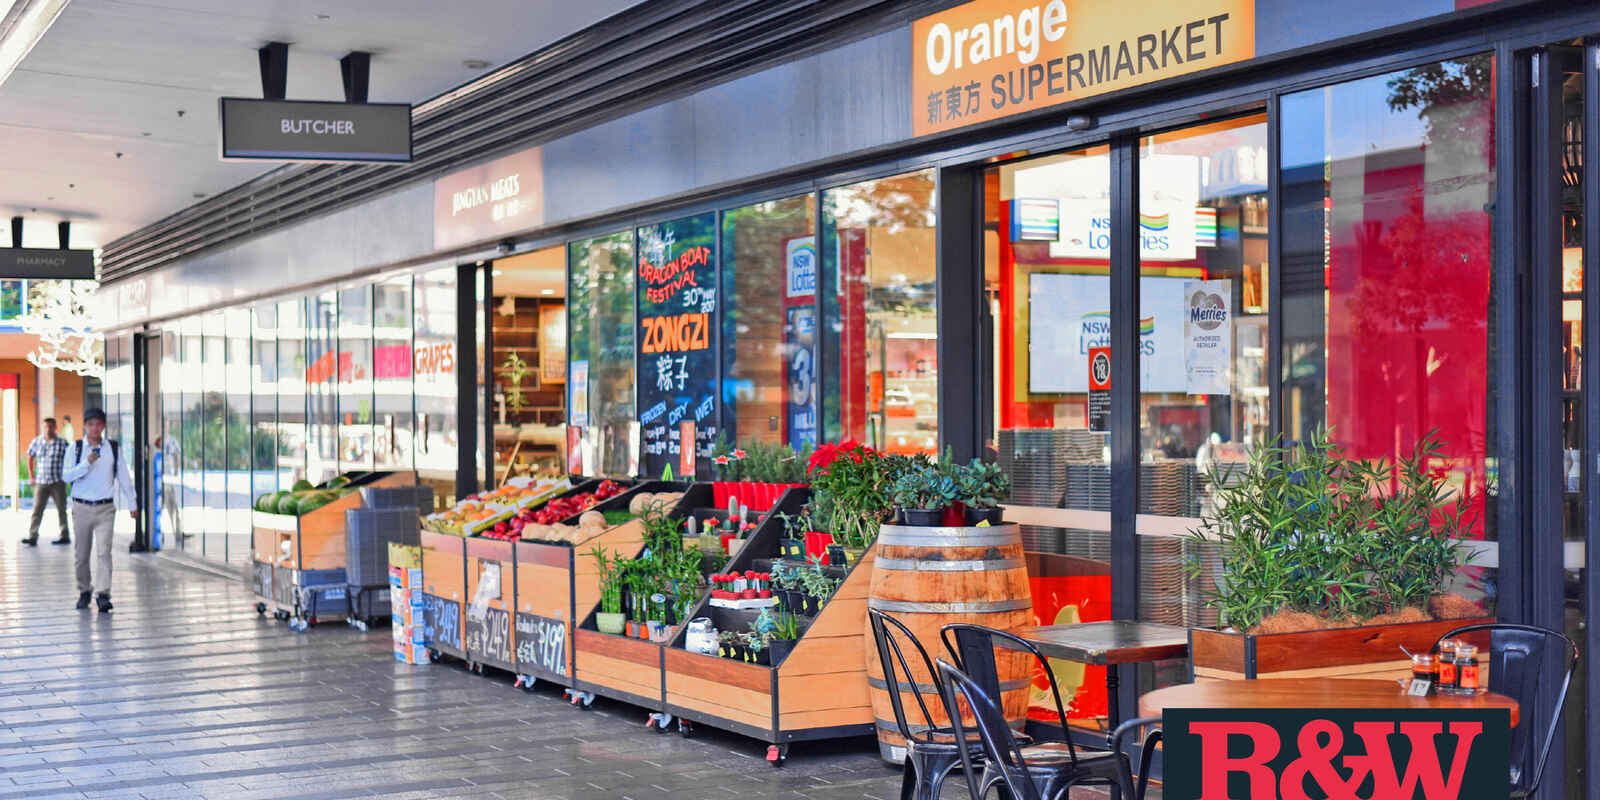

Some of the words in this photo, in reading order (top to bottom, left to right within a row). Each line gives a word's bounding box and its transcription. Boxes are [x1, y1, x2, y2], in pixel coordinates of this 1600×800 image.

[926, 0, 1068, 75] Orange
[926, 80, 982, 124] 新東方
[991, 13, 1230, 110] SUPERMARKET
[281, 119, 355, 135] BUTCHER
[490, 174, 520, 202] MEATS
[1092, 217, 1111, 229] NS
[17, 256, 65, 265] PHARMACY
[680, 245, 711, 271] BOAT
[647, 270, 698, 304] FESTIVAL
[1190, 305, 1227, 323] Merries
[641, 312, 709, 354] ZONGZI
[414, 343, 454, 375] GRAPES
[656, 354, 689, 391] 粽子
[640, 400, 667, 426] FROZEN
[669, 401, 689, 426] DRY
[695, 395, 714, 422] WET
